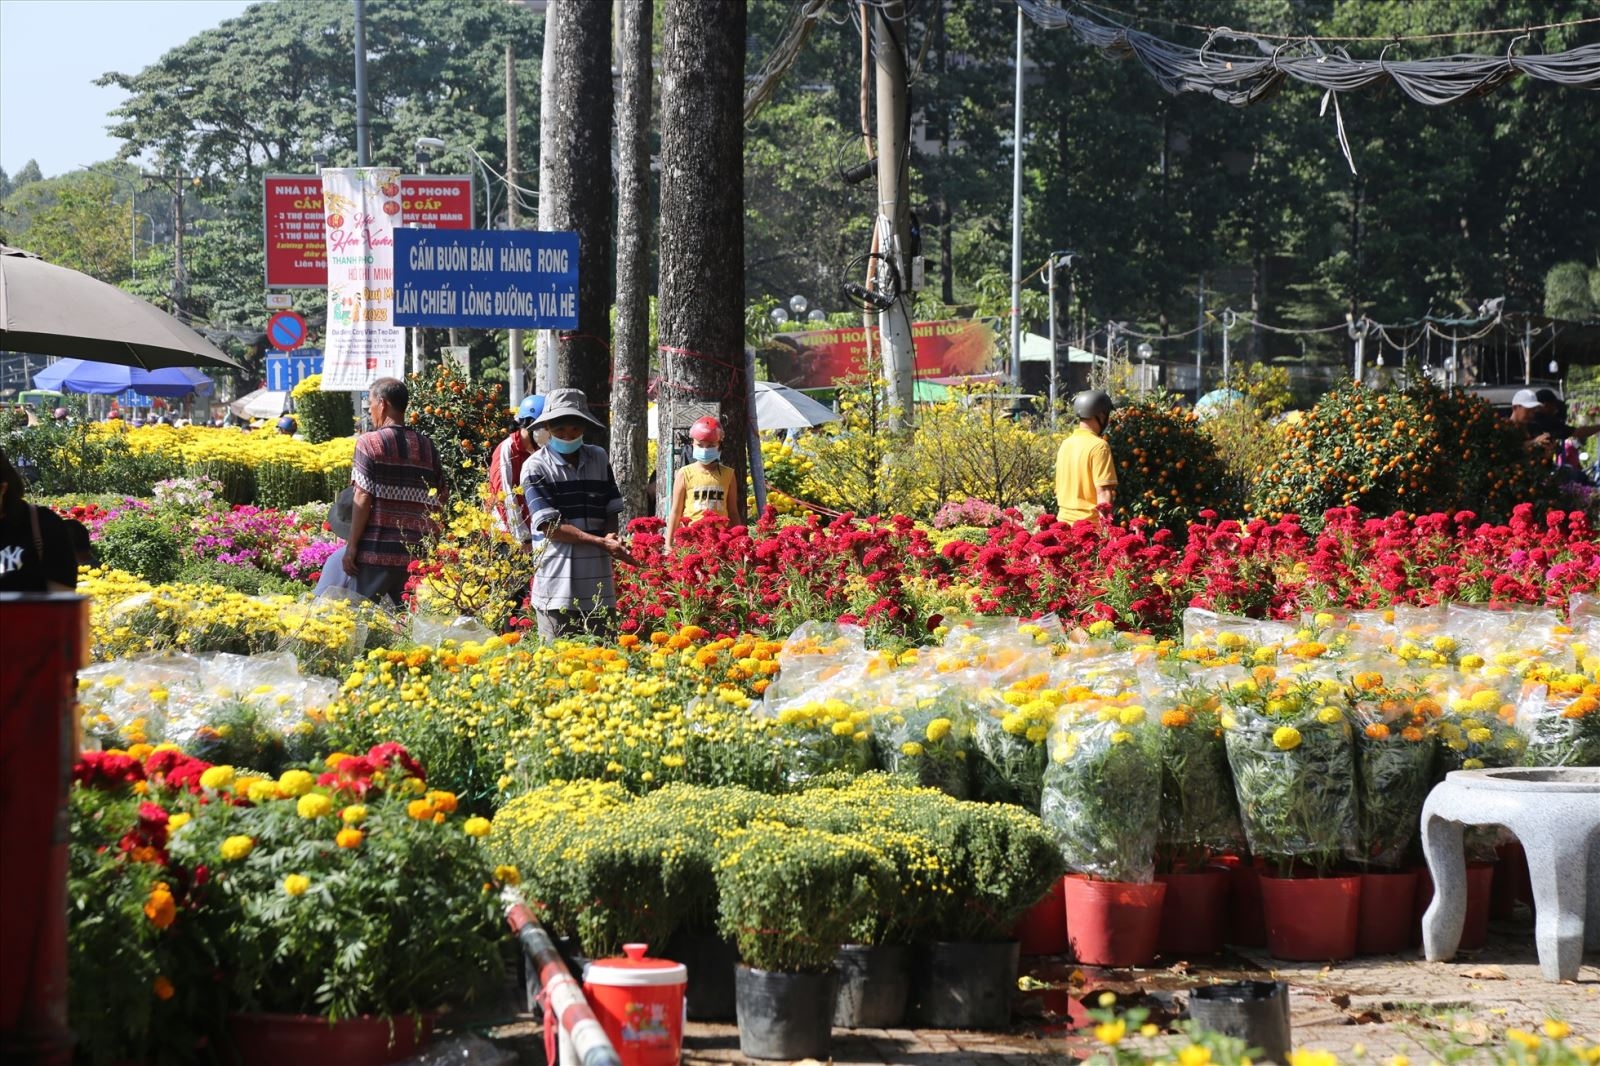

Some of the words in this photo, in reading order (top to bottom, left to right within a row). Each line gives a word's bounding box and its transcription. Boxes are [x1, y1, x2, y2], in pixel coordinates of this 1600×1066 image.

[275, 185, 301, 195] NHÀ
[304, 186, 317, 195] IN
[418, 187, 461, 196] PHONG
[414, 197, 442, 210] GẤP
[409, 238, 434, 271] CẤM
[437, 240, 468, 271] BUÔN
[470, 240, 493, 272] BÁN
[500, 241, 531, 273] HÀNG
[537, 248, 569, 274] RONG
[294, 260, 313, 268] Liên
[396, 282, 418, 314] LẤN
[421, 282, 456, 315] CHIẾM
[462, 284, 492, 316] LÒNG
[494, 284, 537, 321] ĐƯỜNG,
[560, 286, 575, 318] HÈ
[363, 307, 388, 321] 2023
